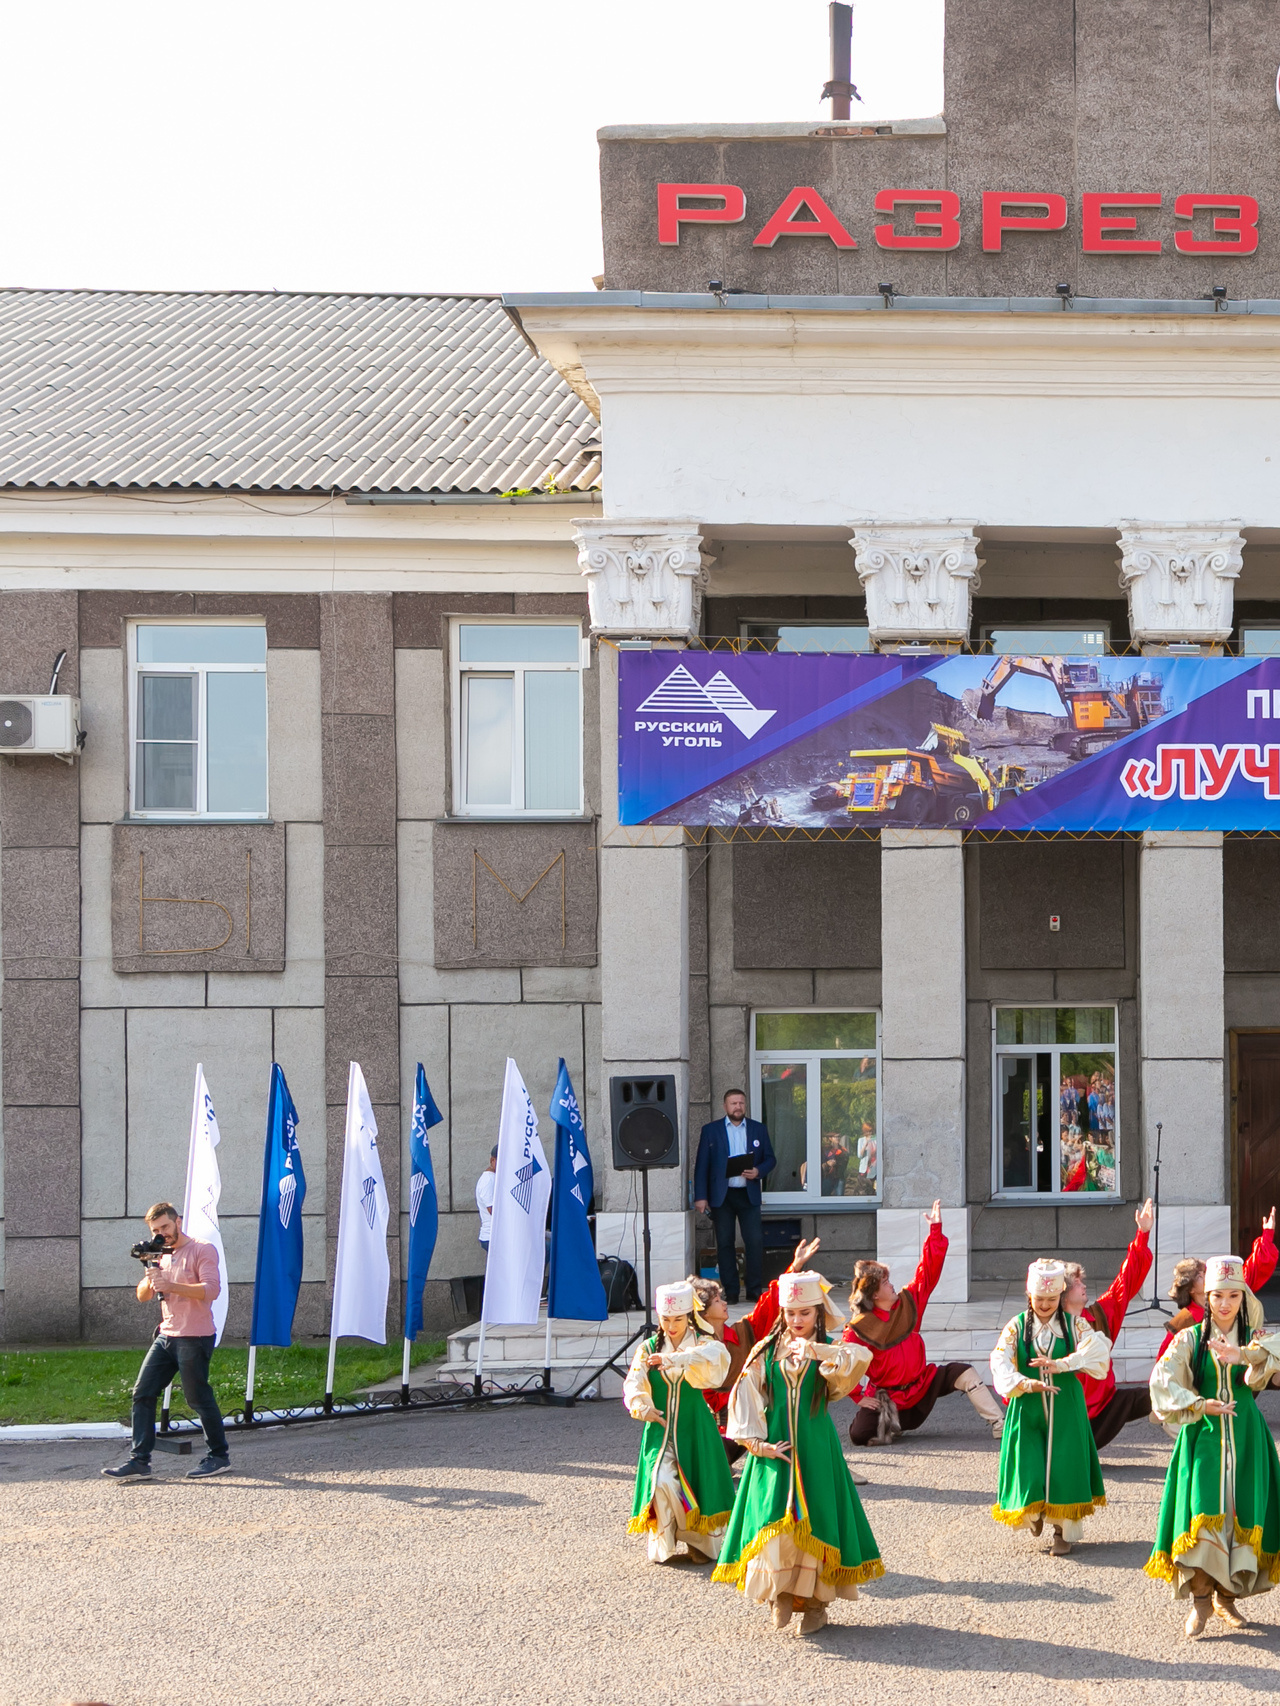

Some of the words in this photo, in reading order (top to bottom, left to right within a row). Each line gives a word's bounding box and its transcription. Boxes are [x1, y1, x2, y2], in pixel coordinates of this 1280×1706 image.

[657, 182, 1260, 257] РАЗРЕЗ
[634, 720, 723, 733] РУССКИЙ
[661, 736, 722, 748] УГОЛЬ
